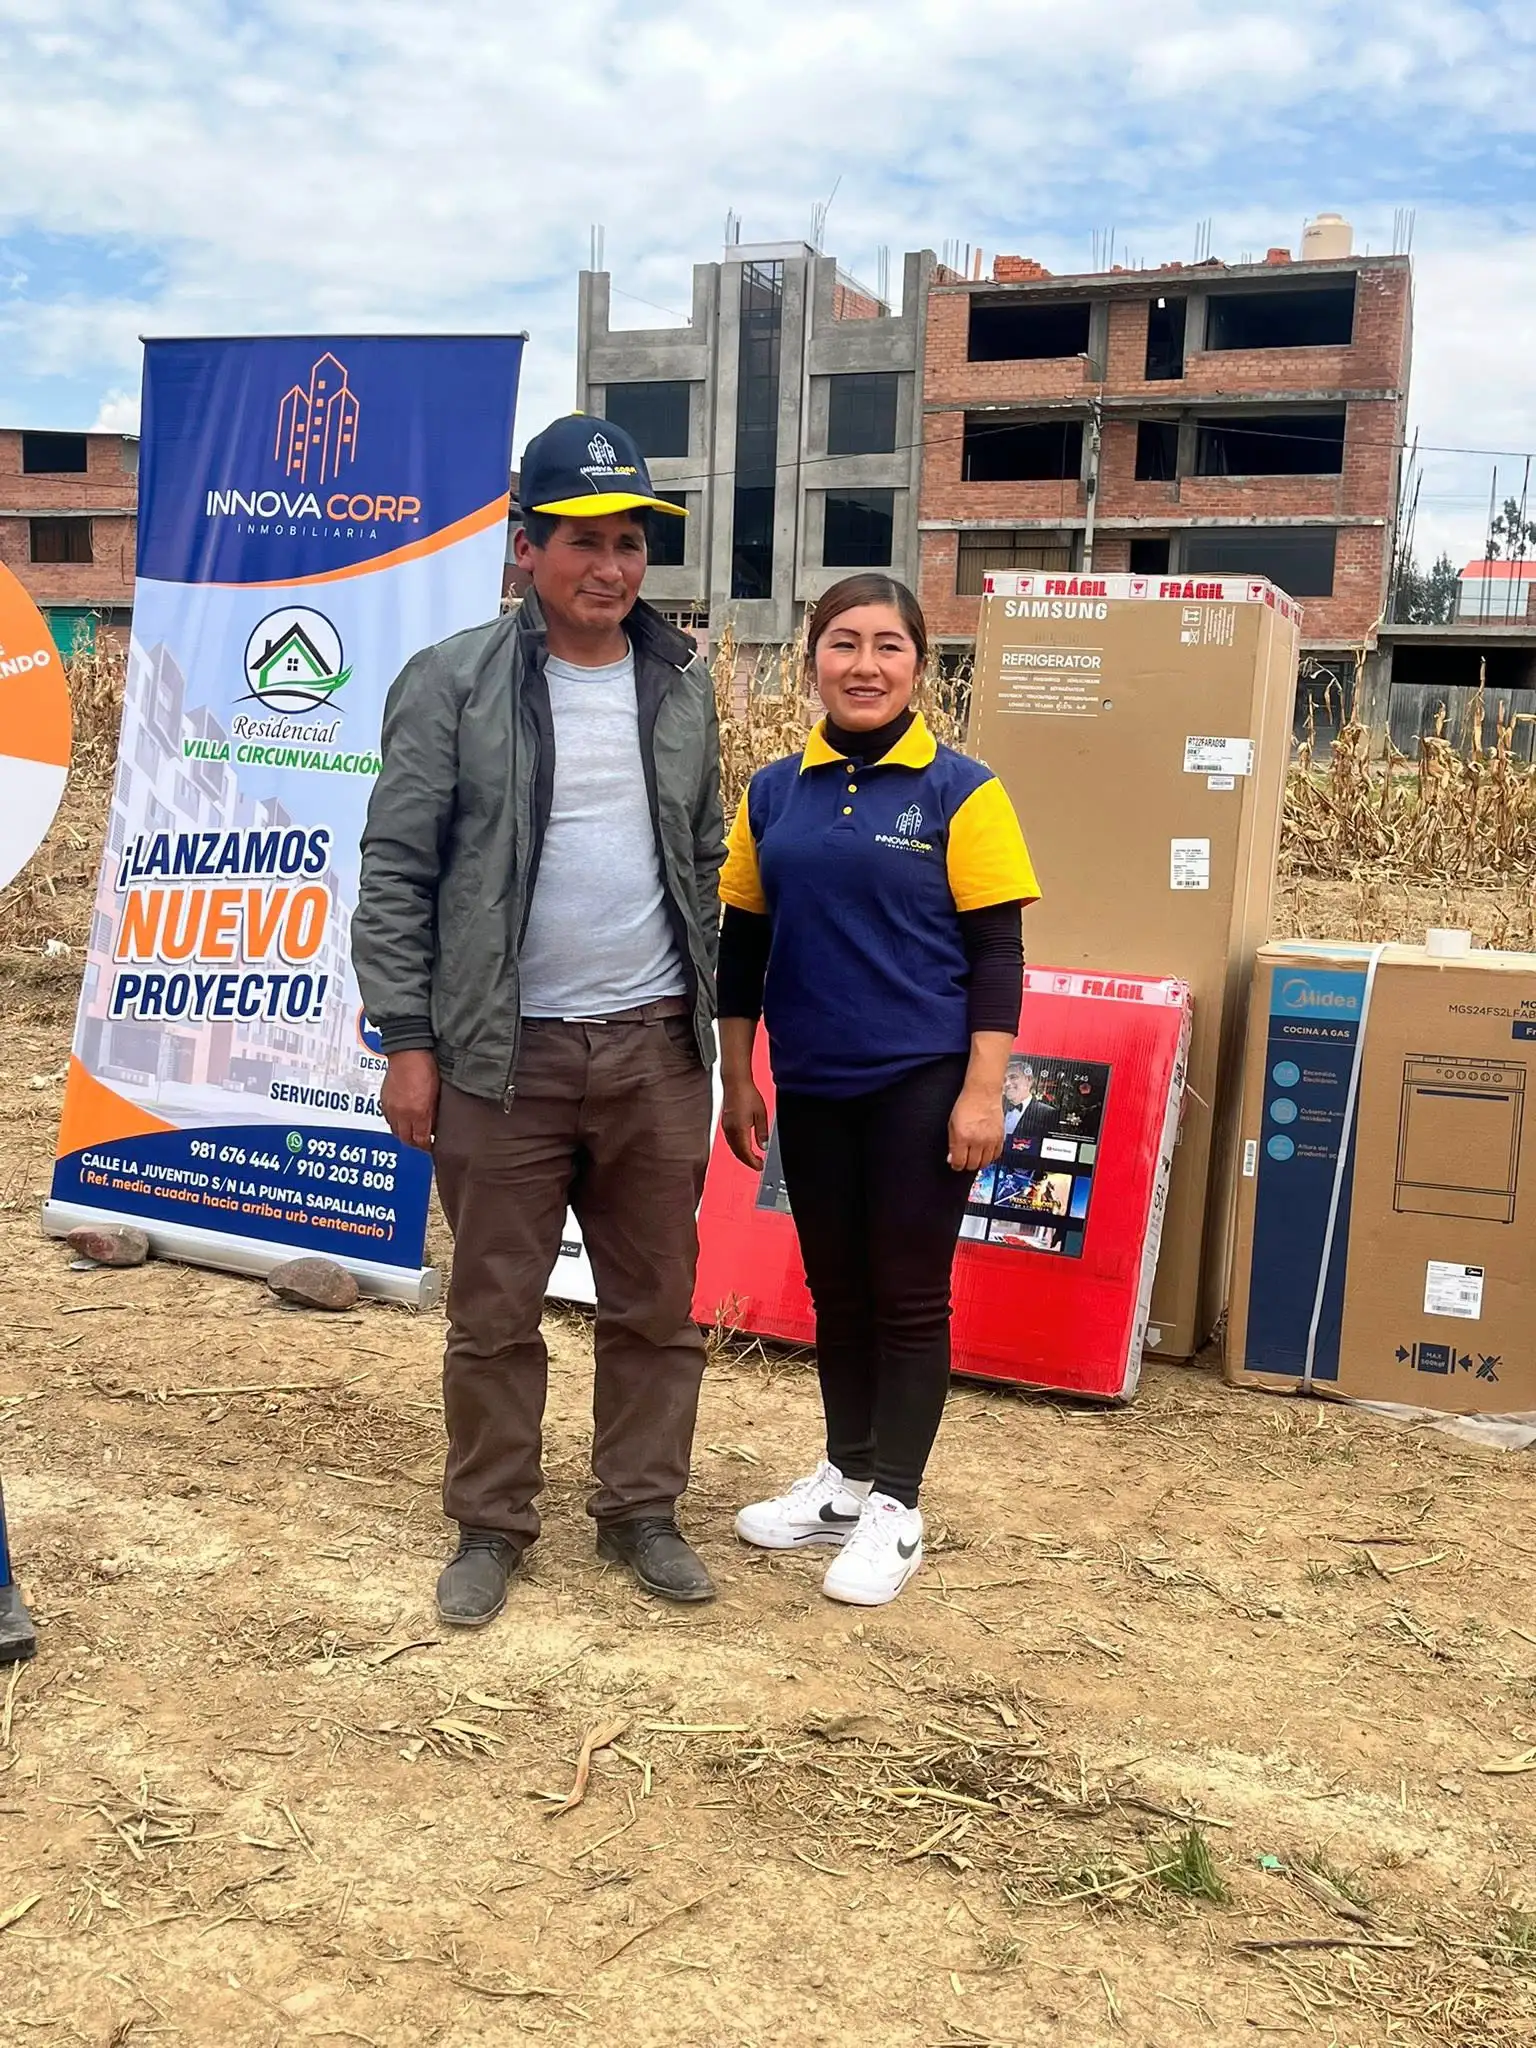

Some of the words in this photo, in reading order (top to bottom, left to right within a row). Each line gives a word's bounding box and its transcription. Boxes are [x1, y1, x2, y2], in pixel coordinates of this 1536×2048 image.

[206, 489, 322, 520] INNOVA
[326, 493, 421, 523] CORP.
[237, 523, 378, 540] INMOBILIARIA
[1045, 577, 1107, 596] FRÁGIL
[1159, 580, 1224, 600] FRÁGIL
[1004, 600, 1108, 620] SAMSUNG
[0, 649, 51, 679] NDO
[1002, 653, 1101, 669] REFRIGERATOR
[233, 715, 340, 743] Residencial
[184, 739, 230, 760] VILLA
[237, 744, 384, 775] CIRCUNVALACIÓN
[875, 834, 910, 845] INNOVA
[119, 829, 330, 887] ¡LANZAMOS
[117, 886, 329, 960] NUEVO
[113, 974, 328, 1018] PROYECTO!
[1081, 980, 1144, 1000] FRÁGIL
[1297, 988, 1357, 1009] Midea
[1283, 1026, 1318, 1036] COCINA
[1331, 1029, 1350, 1038] GAS
[270, 1082, 350, 1111] SERVICIOS
[190, 1140, 216, 1159] 981
[219, 1146, 246, 1165] 676
[249, 1151, 280, 1171] 444
[297, 1159, 325, 1179] 910
[328, 1165, 359, 1185] 203
[362, 1171, 395, 1191] 808
[307, 1139, 336, 1158] 993
[340, 1145, 367, 1164] 661
[371, 1150, 397, 1169] 193
[81, 1153, 120, 1171] CALLE
[122, 1161, 138, 1175] LA
[141, 1164, 209, 1187] JUVENTUD
[211, 1176, 236, 1193] S/N
[239, 1181, 256, 1197] LA
[259, 1185, 303, 1205] PUNTA
[306, 1194, 396, 1222] SAPALLANGA
[87, 1170, 109, 1187] Ref.
[112, 1176, 151, 1194] media
[154, 1185, 199, 1203] cuadra
[202, 1192, 239, 1211] hacia
[242, 1202, 282, 1219] arriba
[285, 1209, 308, 1223] urb
[311, 1214, 385, 1238] centenario
